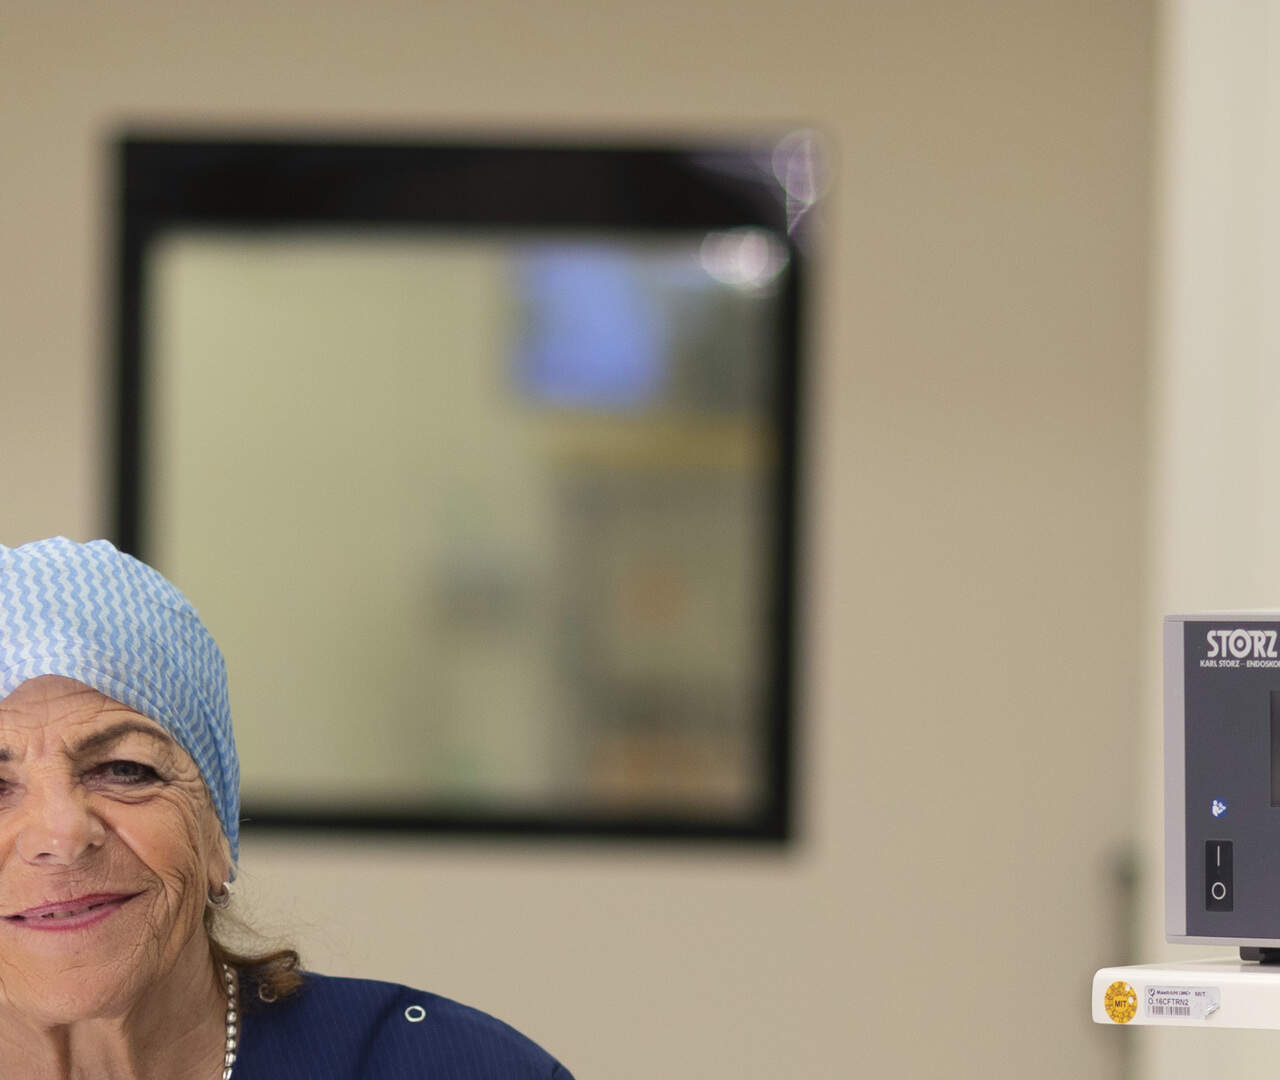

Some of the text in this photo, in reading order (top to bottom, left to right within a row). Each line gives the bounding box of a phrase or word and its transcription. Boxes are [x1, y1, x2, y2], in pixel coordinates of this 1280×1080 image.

[1206, 629, 1278, 659] STORZ
[1200, 660, 1217, 668] KARL
[1219, 660, 1240, 668] STORZ
[1115, 1000, 1127, 1008] MIT
